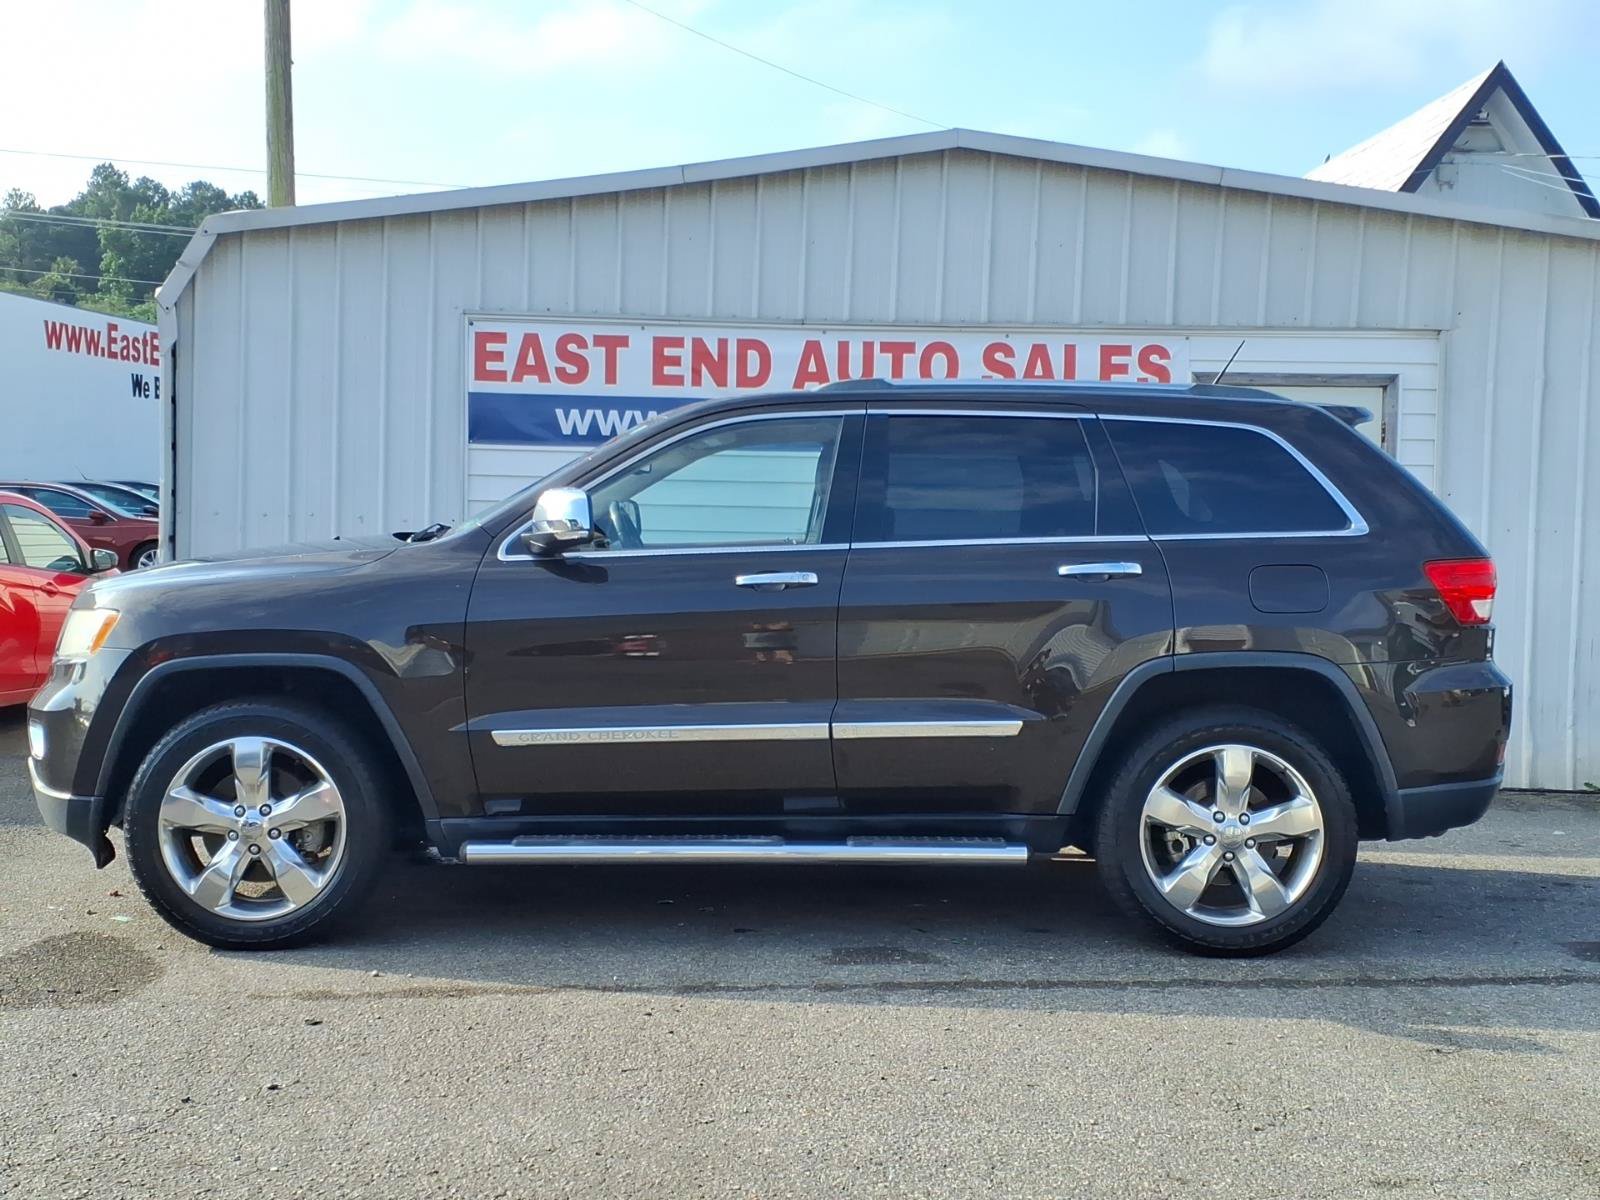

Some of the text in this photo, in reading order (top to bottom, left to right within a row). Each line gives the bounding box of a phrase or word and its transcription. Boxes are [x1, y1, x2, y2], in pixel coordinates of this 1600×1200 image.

[474, 331, 1172, 389] EAST END AUTO SALES
[131, 373, 150, 399] We
[518, 730, 680, 743] GRAND CHEROKEE
